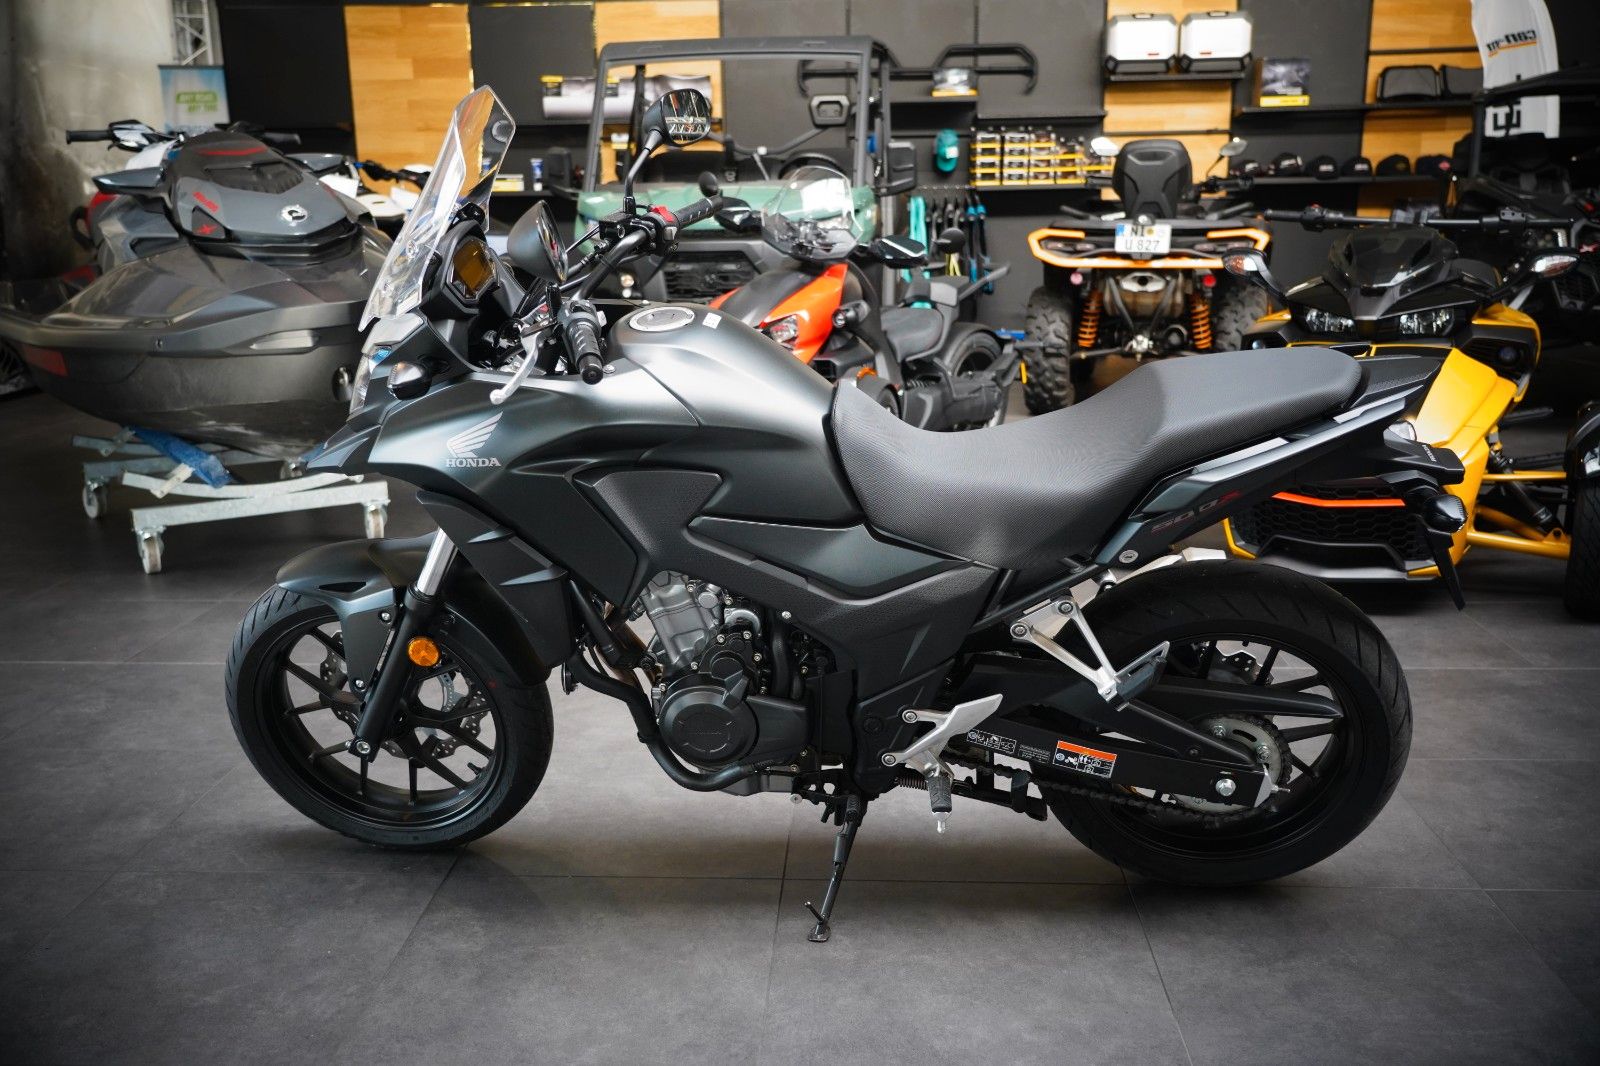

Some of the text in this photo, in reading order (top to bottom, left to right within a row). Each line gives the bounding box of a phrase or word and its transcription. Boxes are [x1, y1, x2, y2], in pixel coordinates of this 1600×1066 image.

[1131, 225, 1145, 237] NI
[1125, 239, 1160, 251] U 827
[446, 457, 502, 468] HONDA
